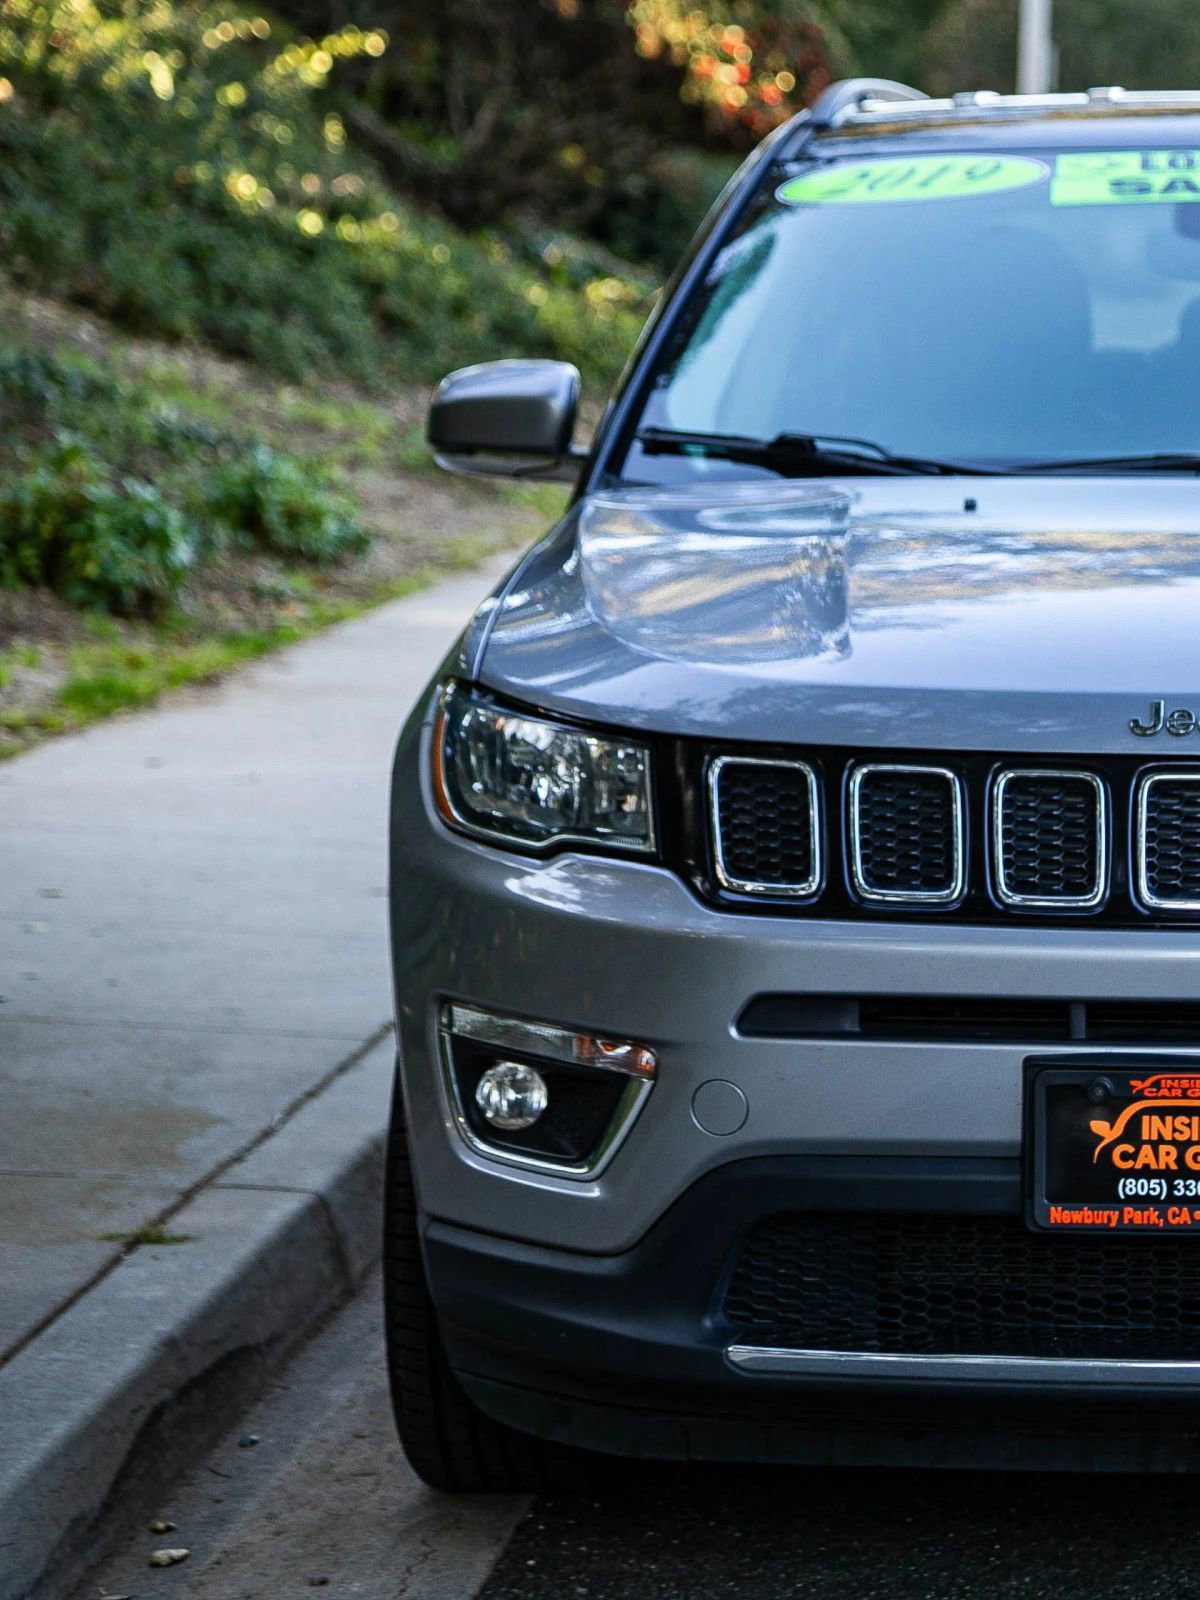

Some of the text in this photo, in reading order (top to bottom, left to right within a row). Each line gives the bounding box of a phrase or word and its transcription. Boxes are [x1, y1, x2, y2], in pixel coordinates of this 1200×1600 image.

[1143, 1088, 1182, 1098] CAR
[1112, 1143, 1179, 1170] CAR
[1118, 1178, 1168, 1200] (805)
[1049, 1206, 1120, 1228] Newbury
[1123, 1206, 1164, 1228] Park,
[1167, 1206, 1192, 1225] CA
